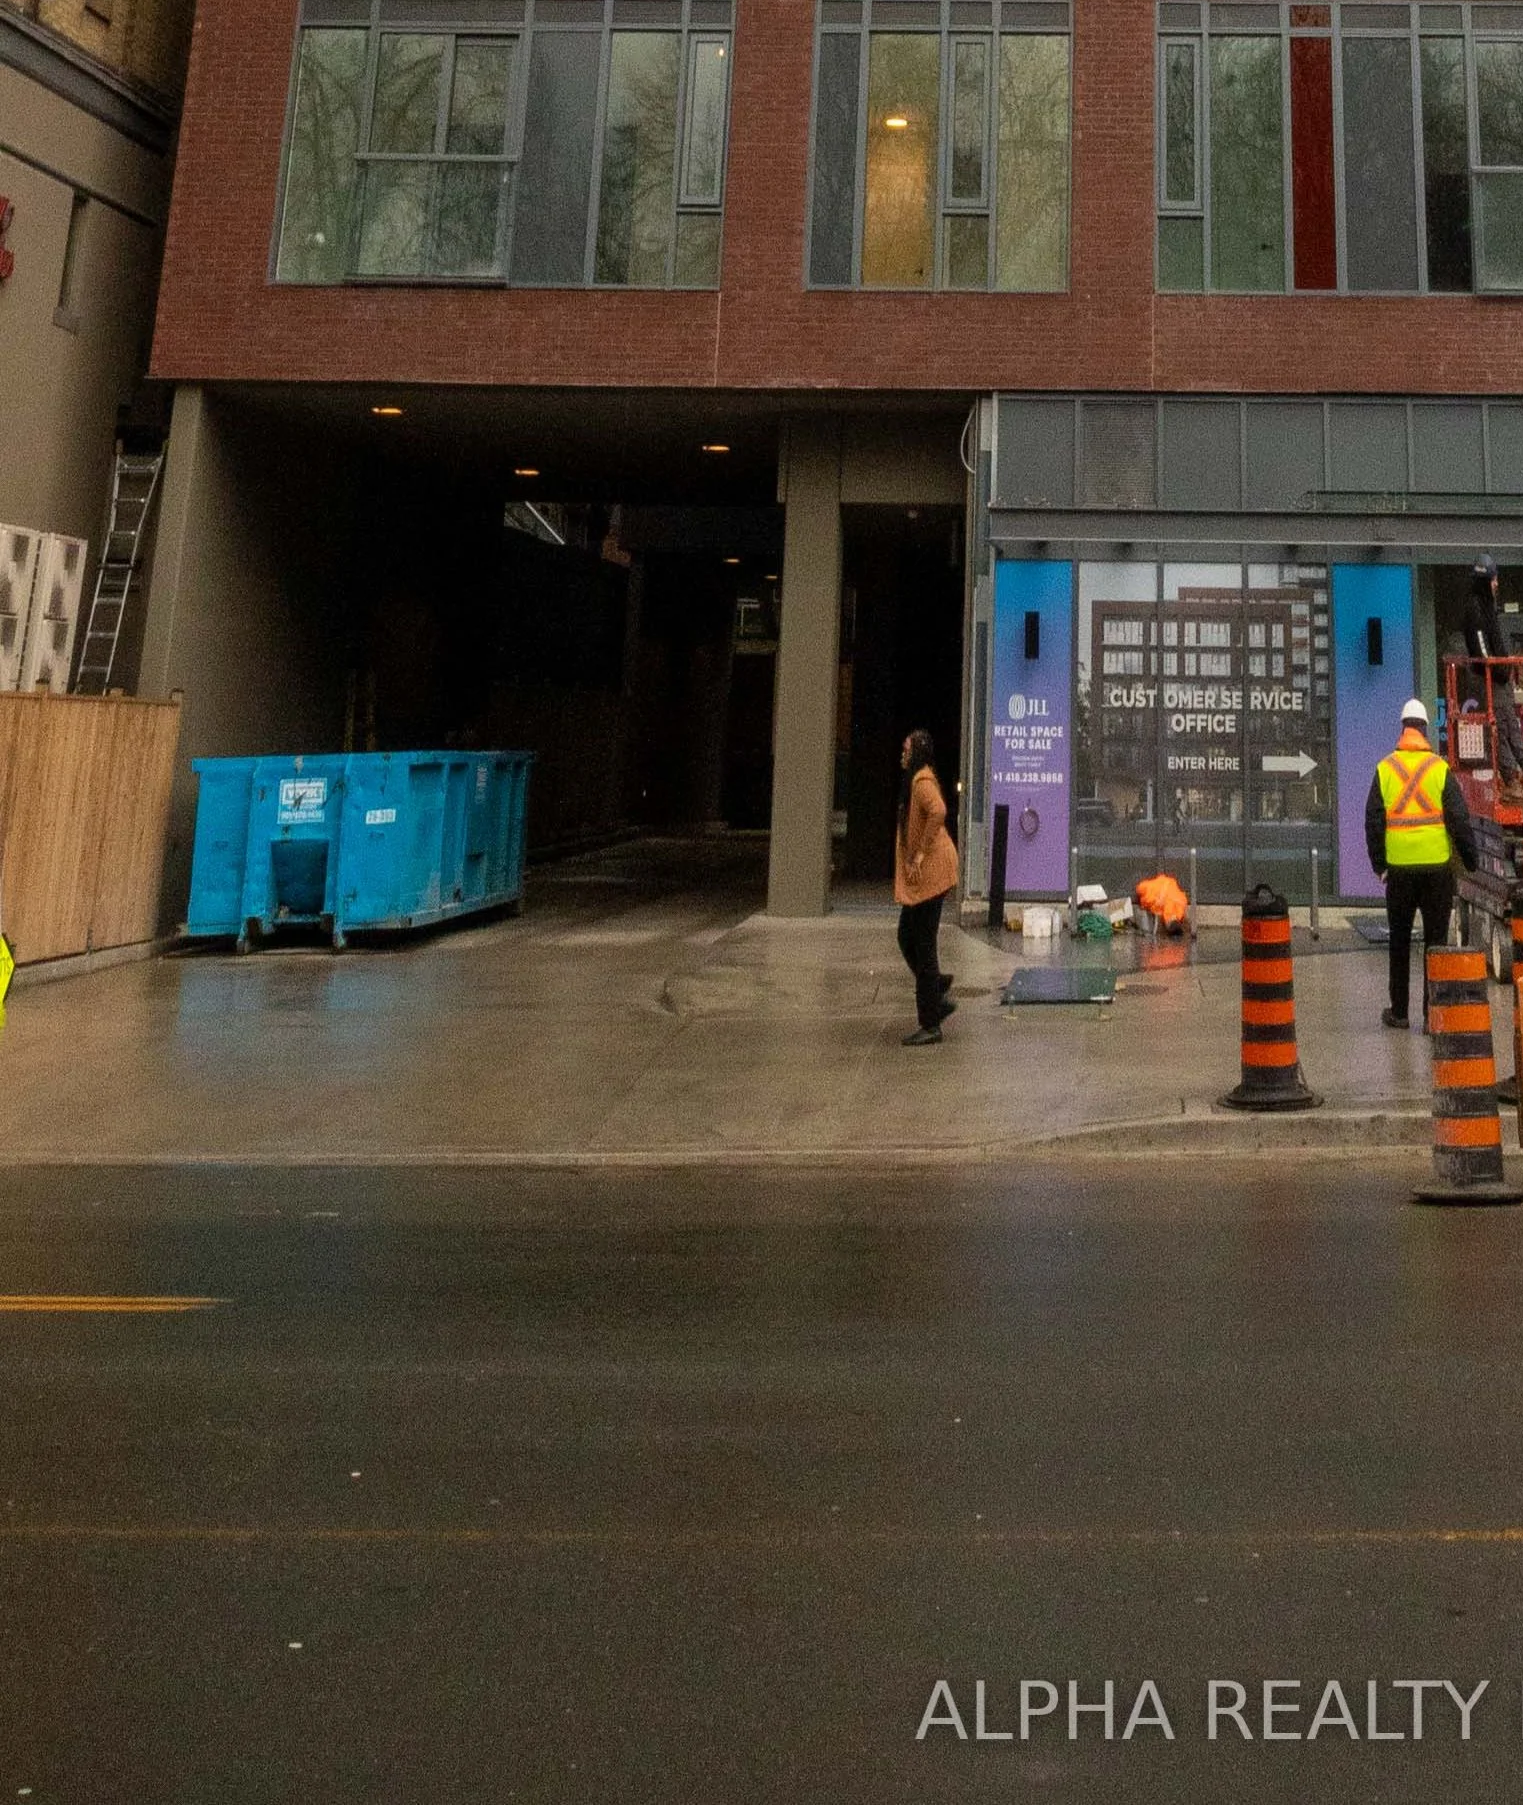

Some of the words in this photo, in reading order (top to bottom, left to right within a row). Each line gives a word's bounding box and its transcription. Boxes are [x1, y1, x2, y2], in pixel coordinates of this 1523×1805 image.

[1026, 698, 1050, 717] JLL
[1171, 713, 1236, 734] OFFICE
[994, 725, 1028, 738] RETAIL
[1030, 726, 1064, 738] SPACE
[1005, 738, 1026, 750] FOR
[1028, 738, 1052, 751] SALE
[1167, 756, 1206, 771] ENTER
[1208, 756, 1240, 771] HERE
[993, 772, 1003, 784] +1
